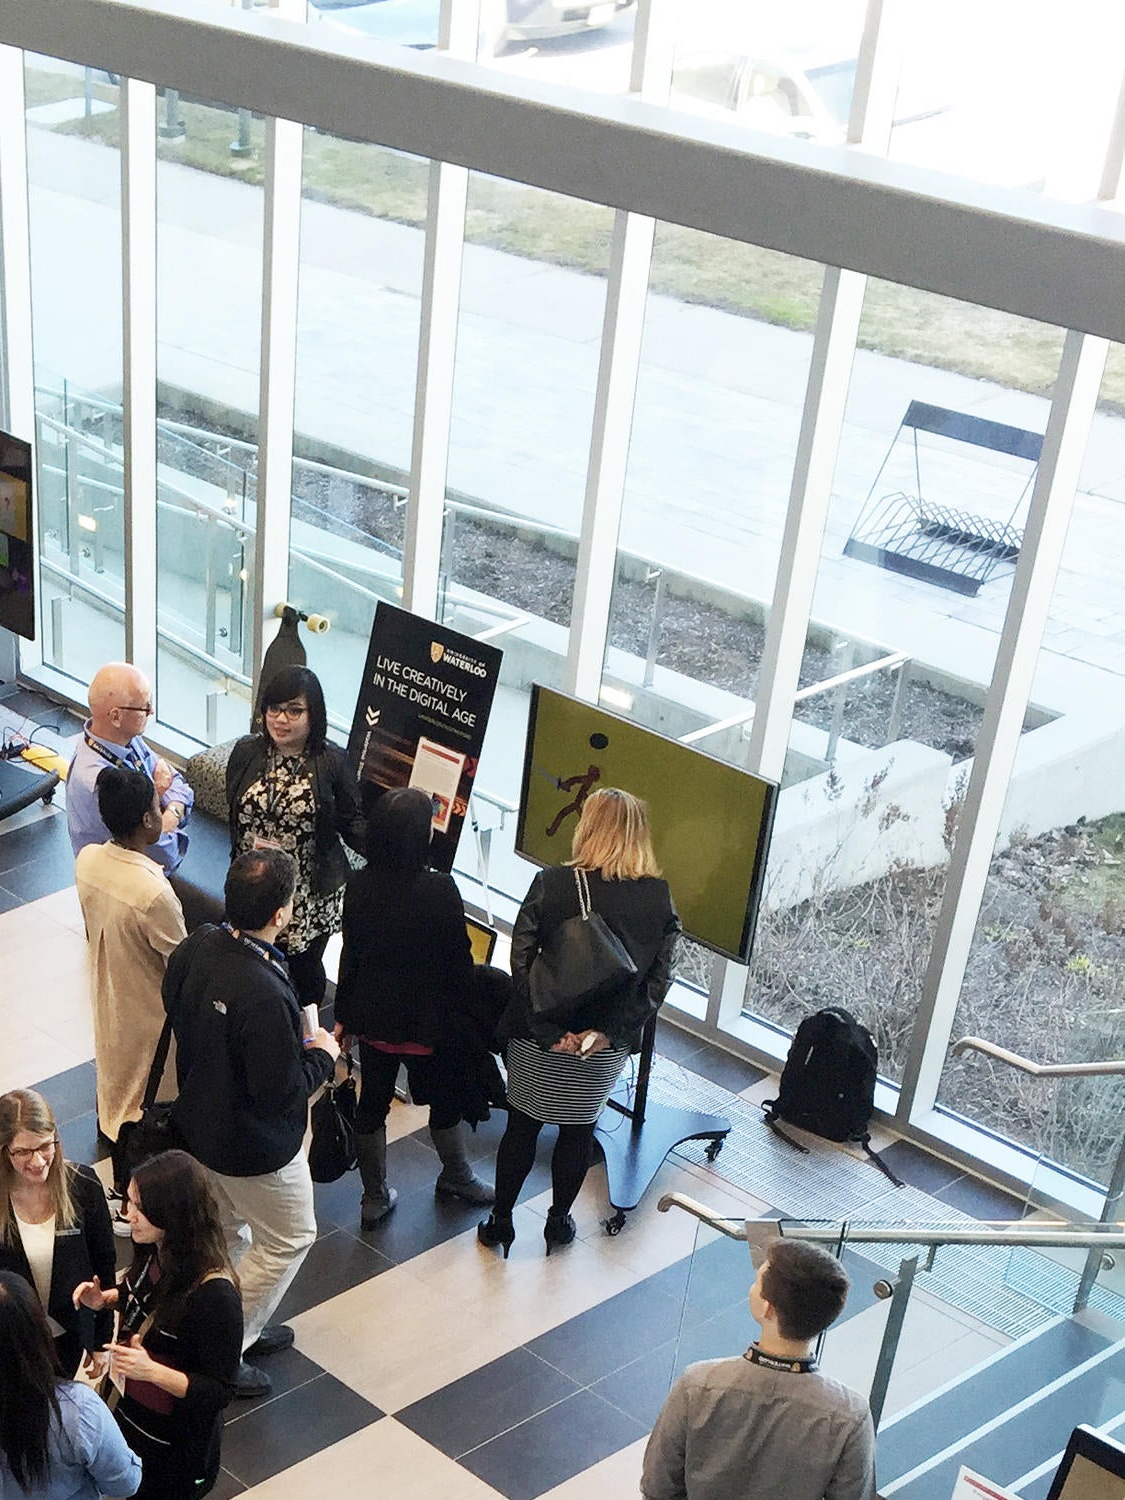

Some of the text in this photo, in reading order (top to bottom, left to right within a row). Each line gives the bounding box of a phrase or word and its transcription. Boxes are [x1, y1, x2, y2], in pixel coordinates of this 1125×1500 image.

[376, 655, 467, 702] LIVE CREATIVELY
[443, 652, 487, 678] WATERLOO
[373, 673, 385, 688] IN
[387, 678, 407, 698] THE
[409, 690, 450, 717] DIGITAL
[452, 708, 476, 727] AGE
